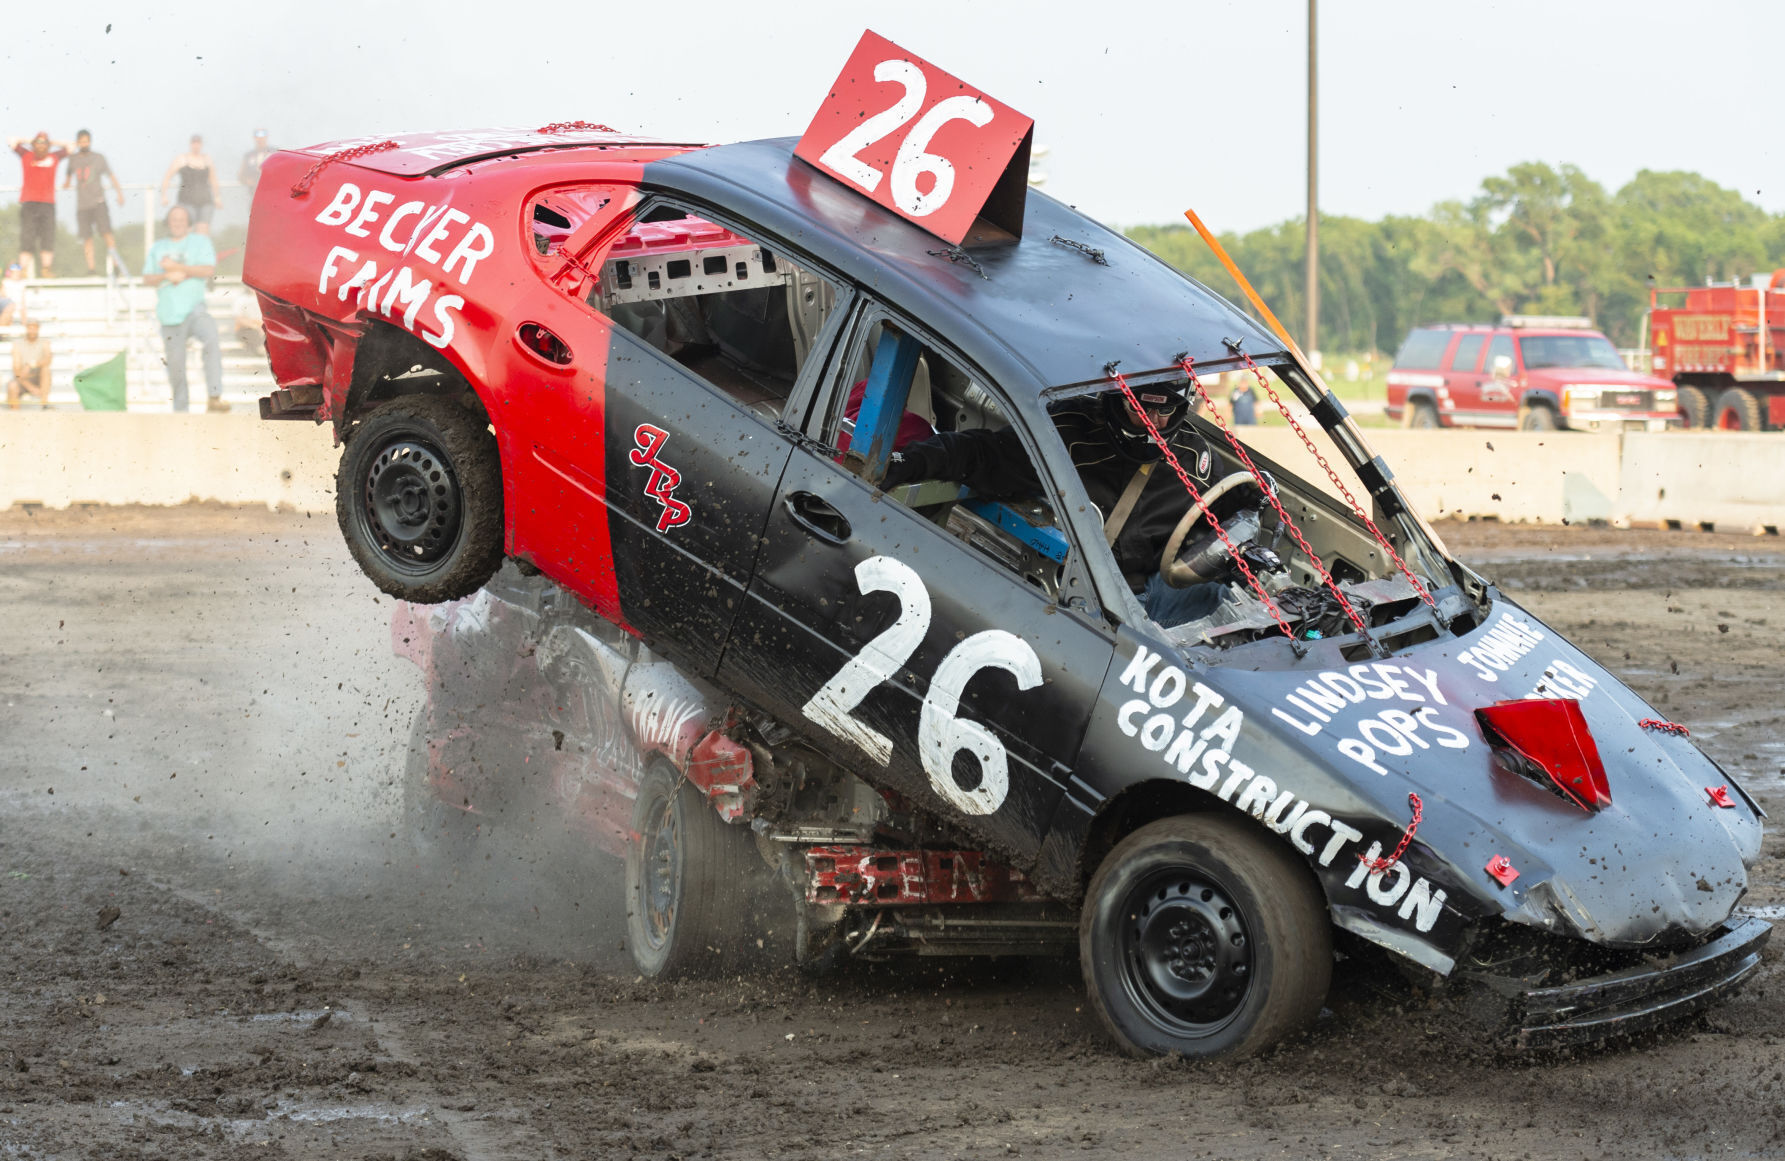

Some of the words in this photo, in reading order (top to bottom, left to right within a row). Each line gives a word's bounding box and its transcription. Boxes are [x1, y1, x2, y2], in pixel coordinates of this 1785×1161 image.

[818, 59, 995, 217] 26
[801, 554, 1045, 816] 26
[1456, 612, 1546, 682] JOHNNIE
[1119, 645, 1244, 754] KOTA
[1271, 663, 1449, 737] LINDSEY
[1337, 706, 1470, 776] POPS
